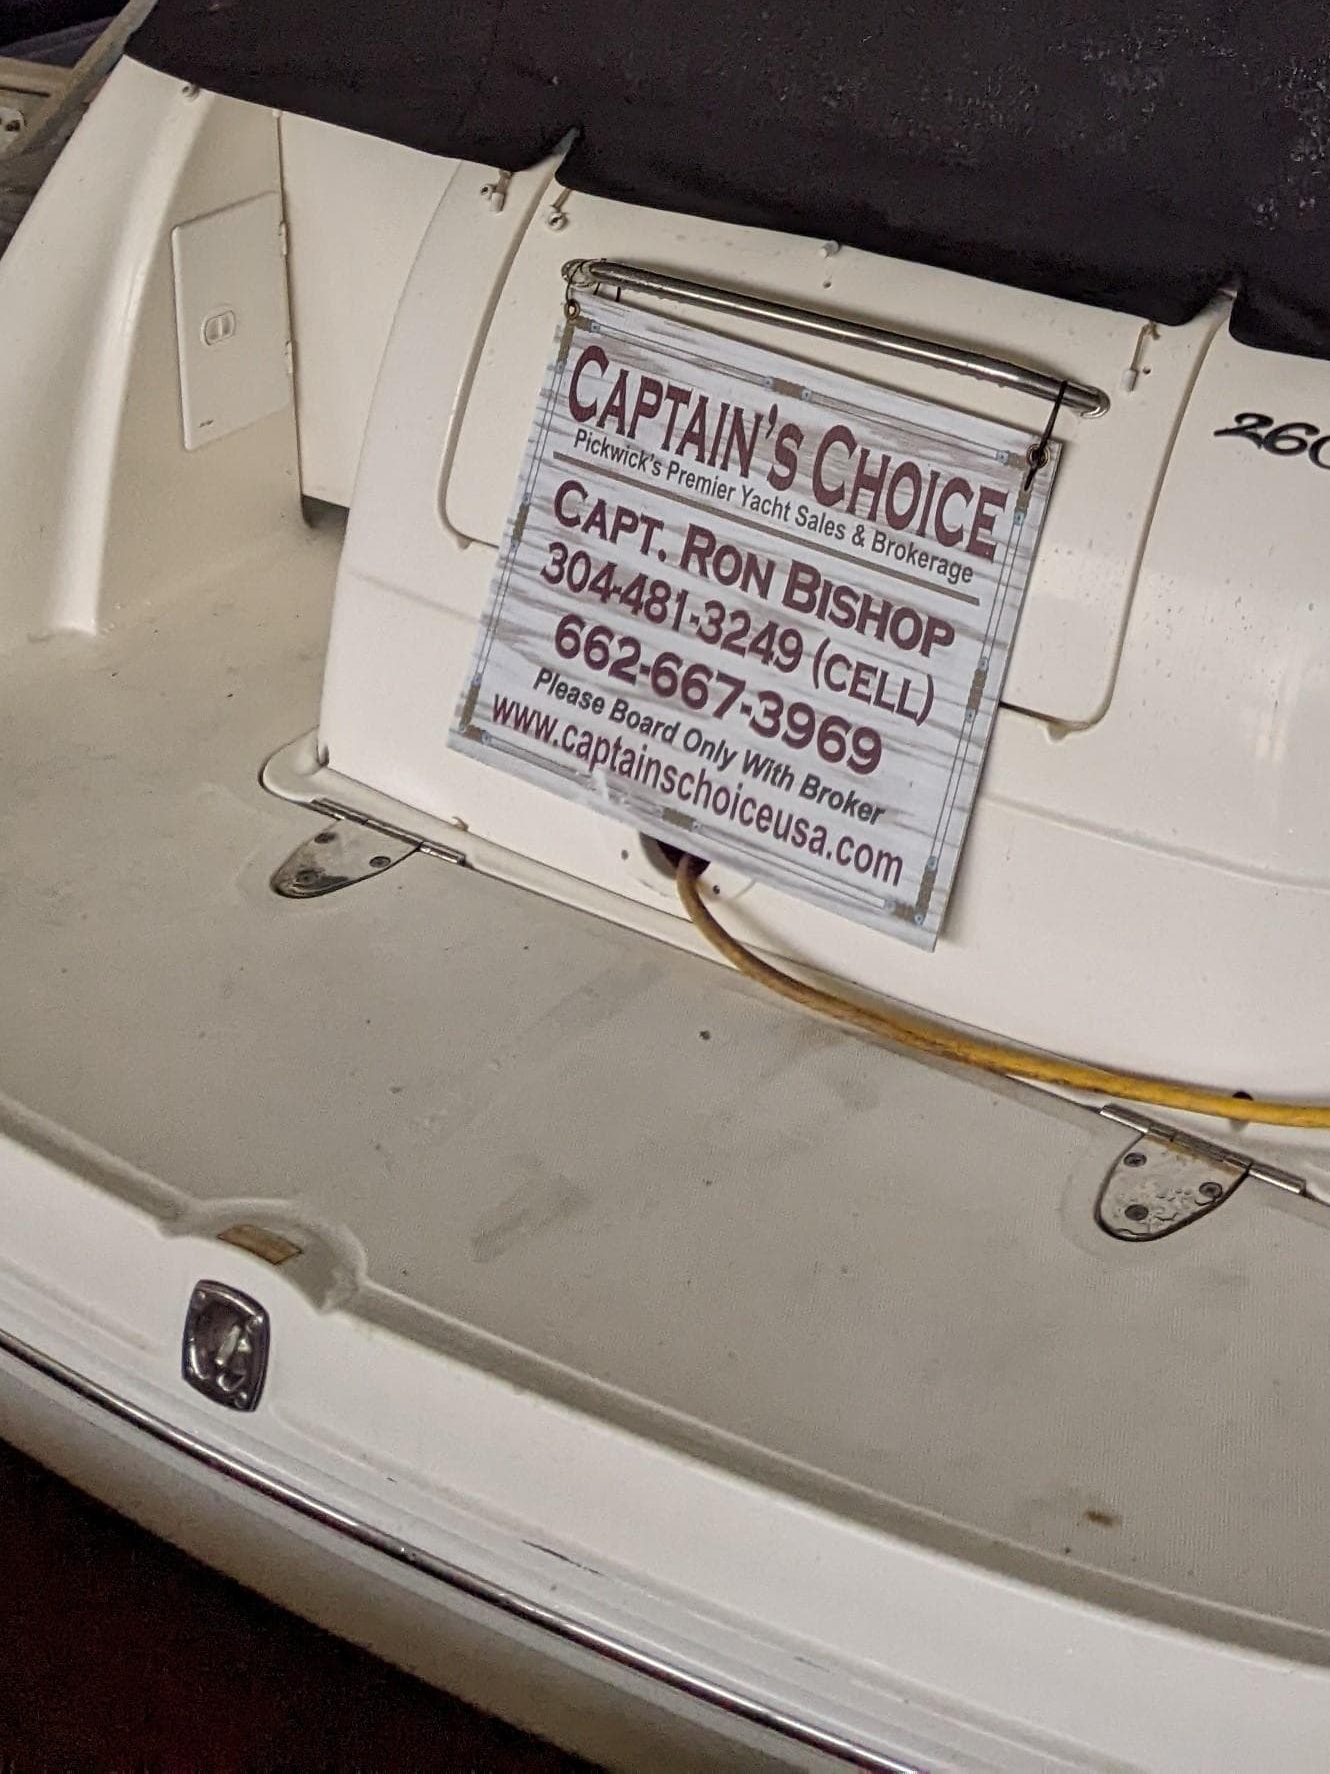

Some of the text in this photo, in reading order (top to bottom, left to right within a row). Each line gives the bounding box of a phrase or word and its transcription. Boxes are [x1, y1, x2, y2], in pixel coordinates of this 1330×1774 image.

[567, 344, 1009, 564] CAPTAIN'S CHOICE
[573, 428, 975, 586] Pickwick's Premier Yacht Sales & Brokerage
[539, 540, 936, 727] 304-481-3249 (CELL)
[553, 478, 956, 659] CAPT. RON BISHOP
[532, 666, 887, 827] Please Board Only With Broker
[554, 613, 883, 776] 662-667-3969
[491, 692, 904, 888] www.captainschoiceusa.com
